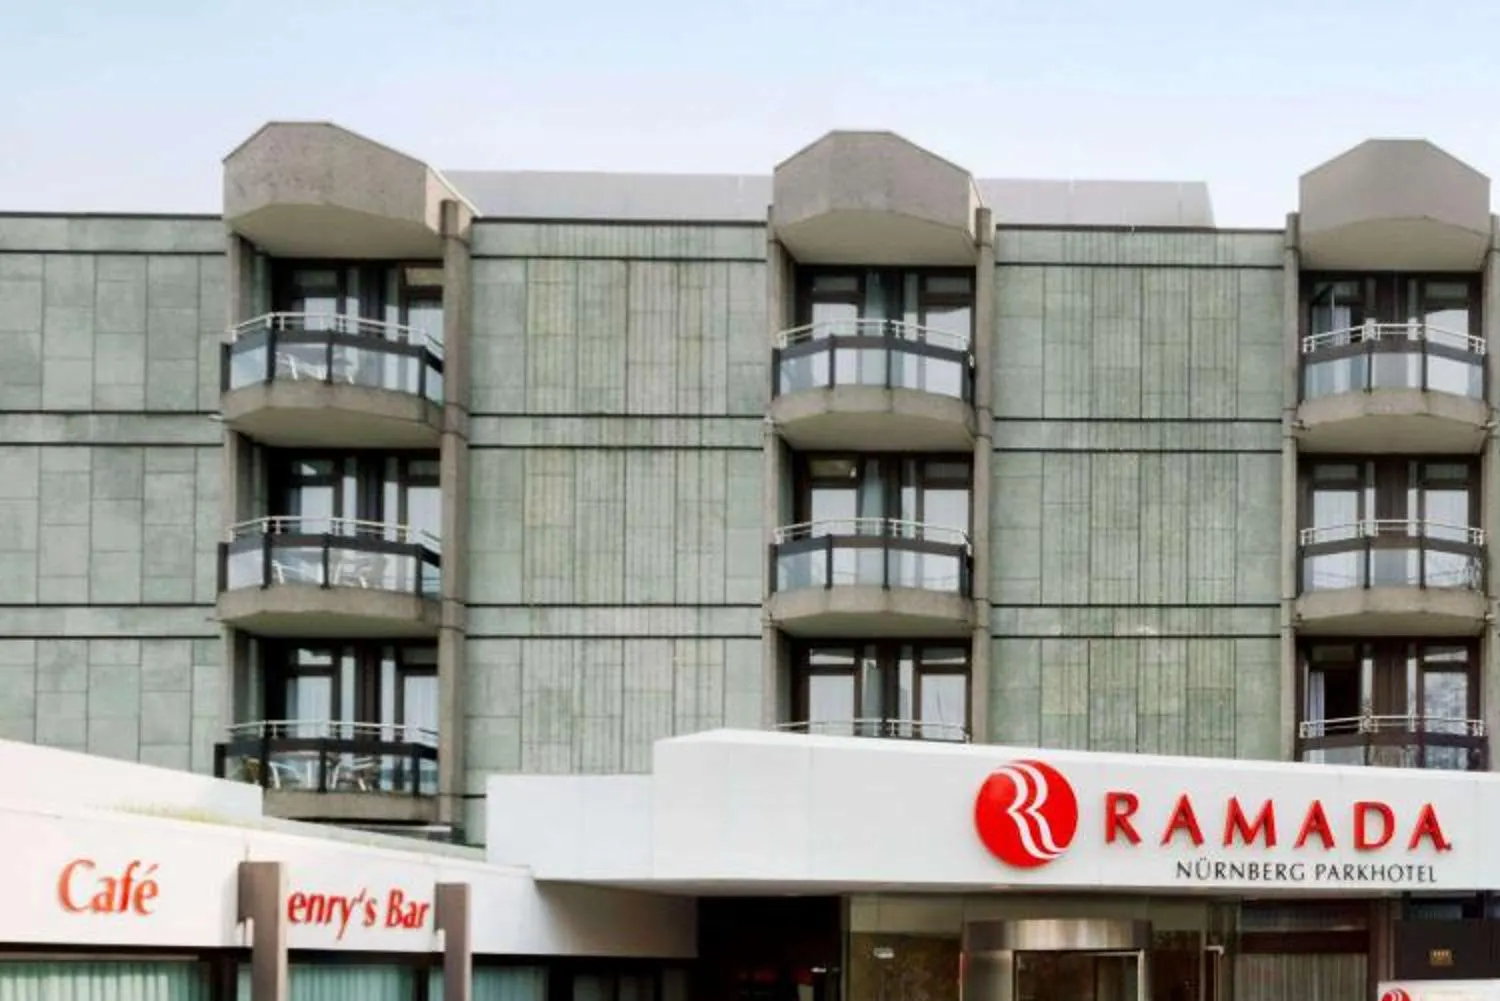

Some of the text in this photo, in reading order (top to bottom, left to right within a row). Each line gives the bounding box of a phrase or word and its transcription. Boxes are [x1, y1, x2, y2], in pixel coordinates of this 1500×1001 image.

[1104, 790, 1453, 852] RAMADA
[57, 858, 160, 917] Café
[1175, 857, 1438, 883] NÜRNBERG PARKHOTEL
[286, 887, 429, 941] enry's Bar
